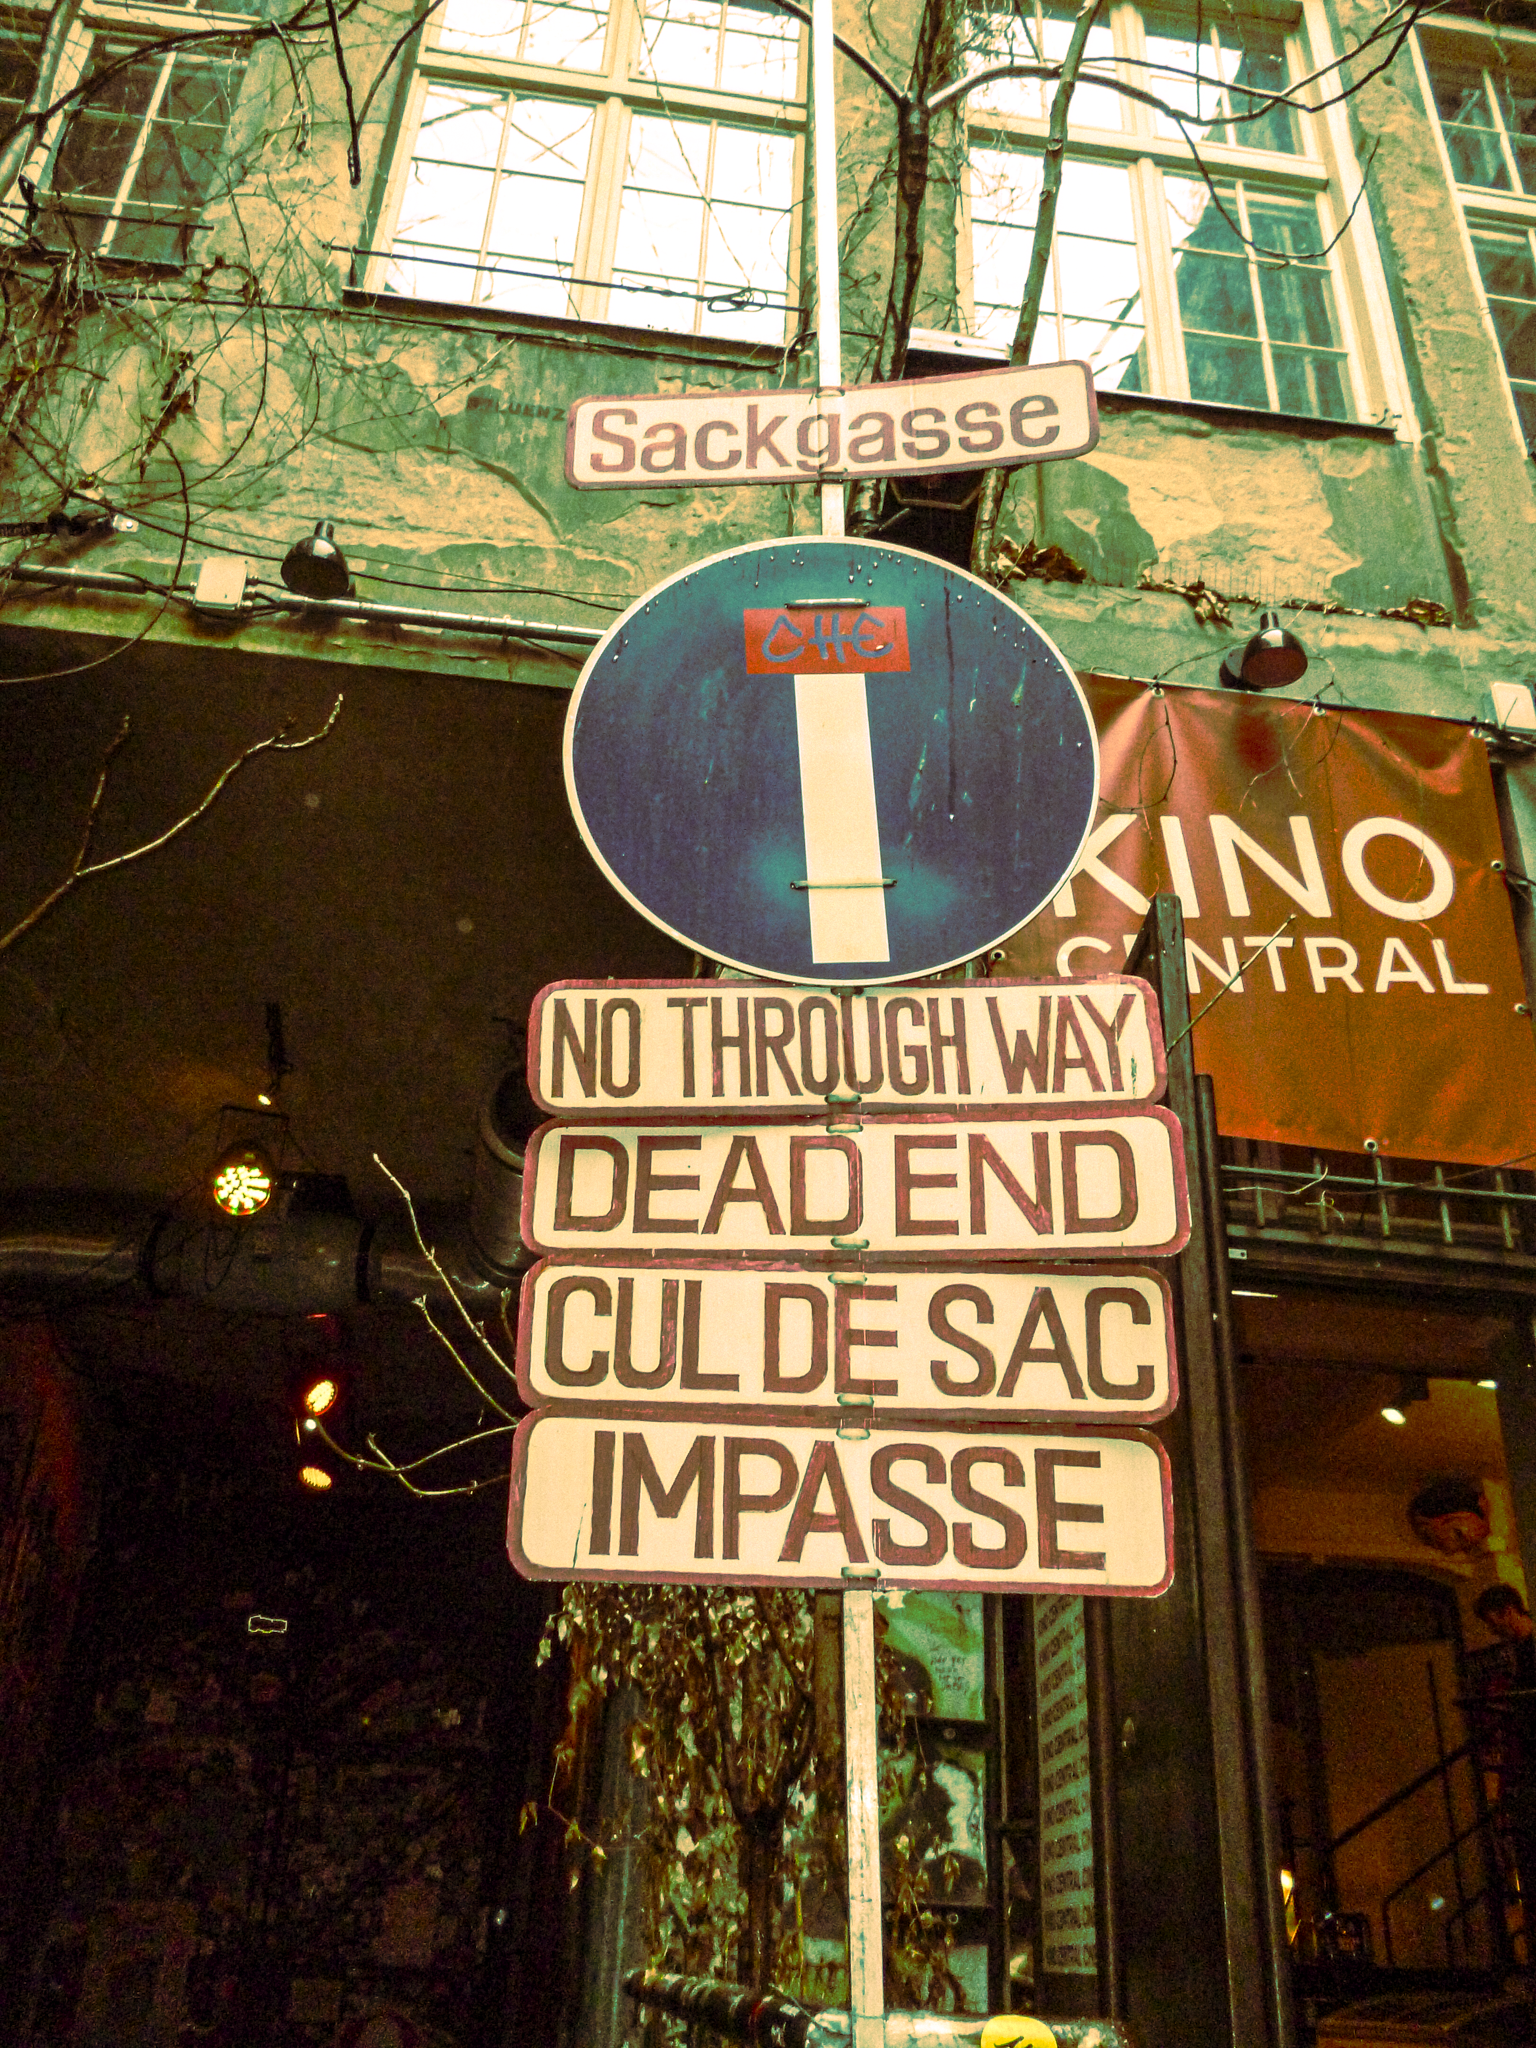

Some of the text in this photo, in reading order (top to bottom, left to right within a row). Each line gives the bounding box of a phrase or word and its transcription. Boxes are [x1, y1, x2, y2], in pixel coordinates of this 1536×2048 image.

[589, 394, 1061, 473] Sackgasse
[761, 612, 894, 664] CHE
[1053, 813, 1456, 921] KINO
[1056, 936, 1490, 994] CNTRAL
[550, 993, 1137, 1098] NO THROUGH WAY
[553, 1130, 1140, 1237] DEAD END
[543, 1275, 1155, 1400] CUL DE SAC
[588, 1430, 1107, 1571] IMPASSE
